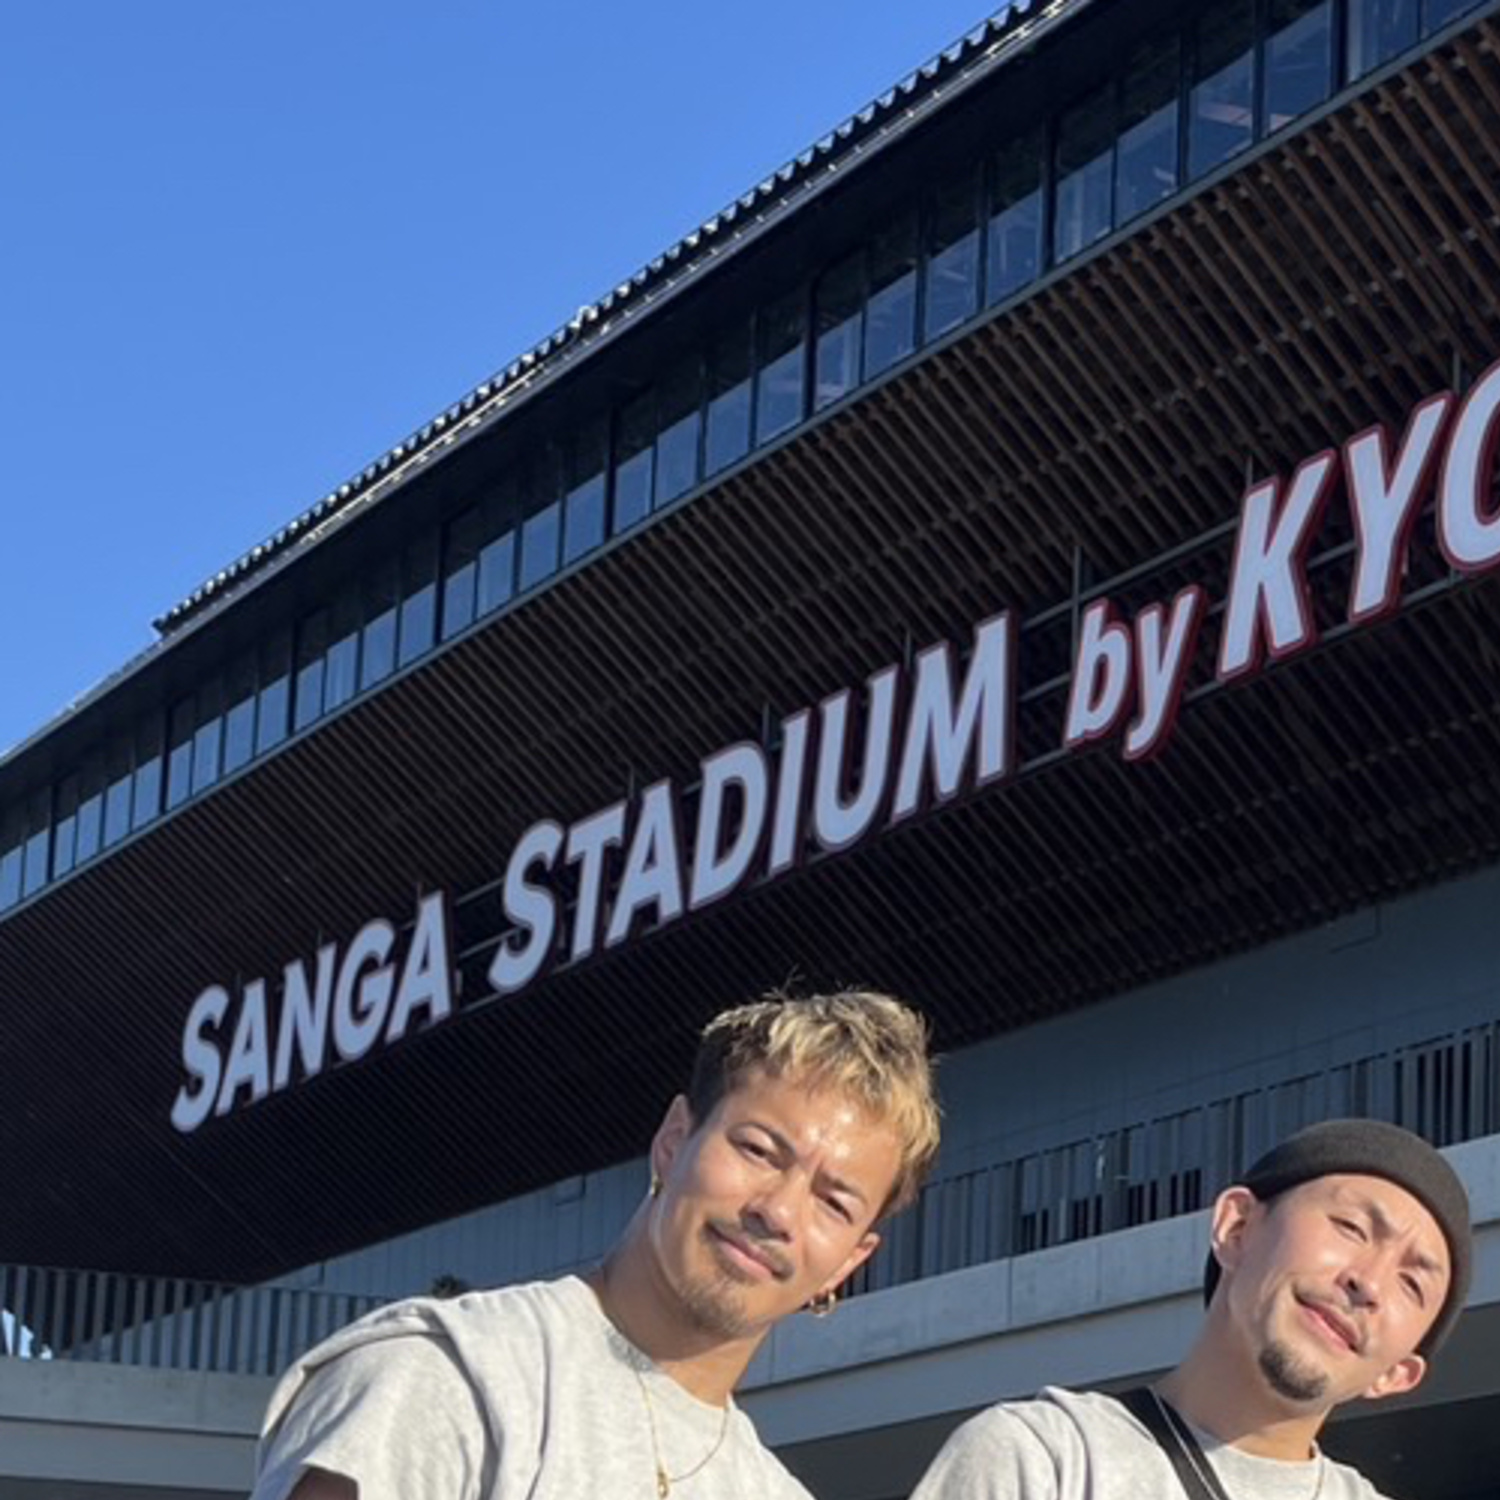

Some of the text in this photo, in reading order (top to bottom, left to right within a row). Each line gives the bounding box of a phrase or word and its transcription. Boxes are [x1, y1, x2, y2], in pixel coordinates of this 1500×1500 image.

[170, 888, 453, 1133] SANGA
[488, 609, 1011, 994] STADIUM
[1062, 583, 1203, 762] by
